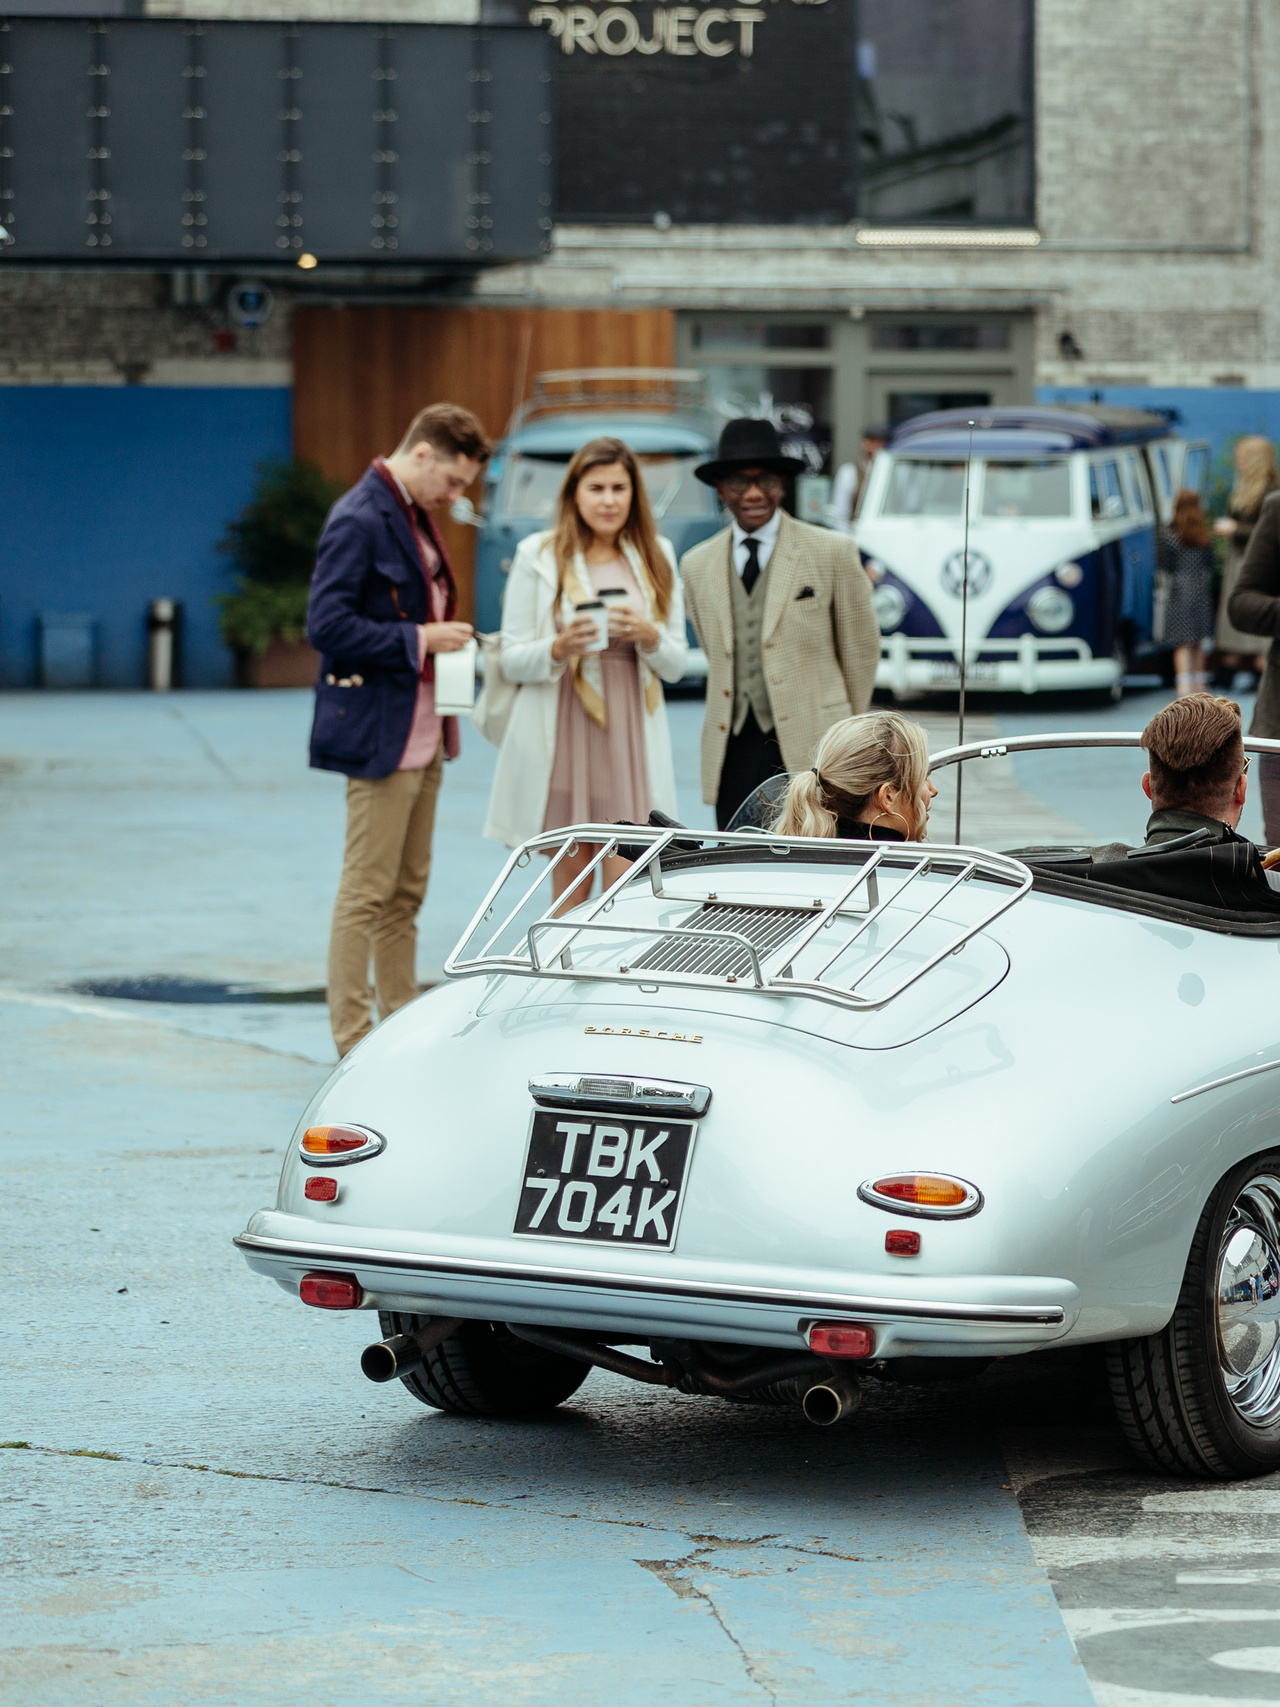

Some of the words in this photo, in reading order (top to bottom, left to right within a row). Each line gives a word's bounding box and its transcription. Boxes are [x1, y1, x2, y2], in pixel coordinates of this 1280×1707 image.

[584, 1026, 703, 1044] PORSCHE
[556, 1121, 669, 1182] TBK
[525, 1177, 677, 1241] 704K
